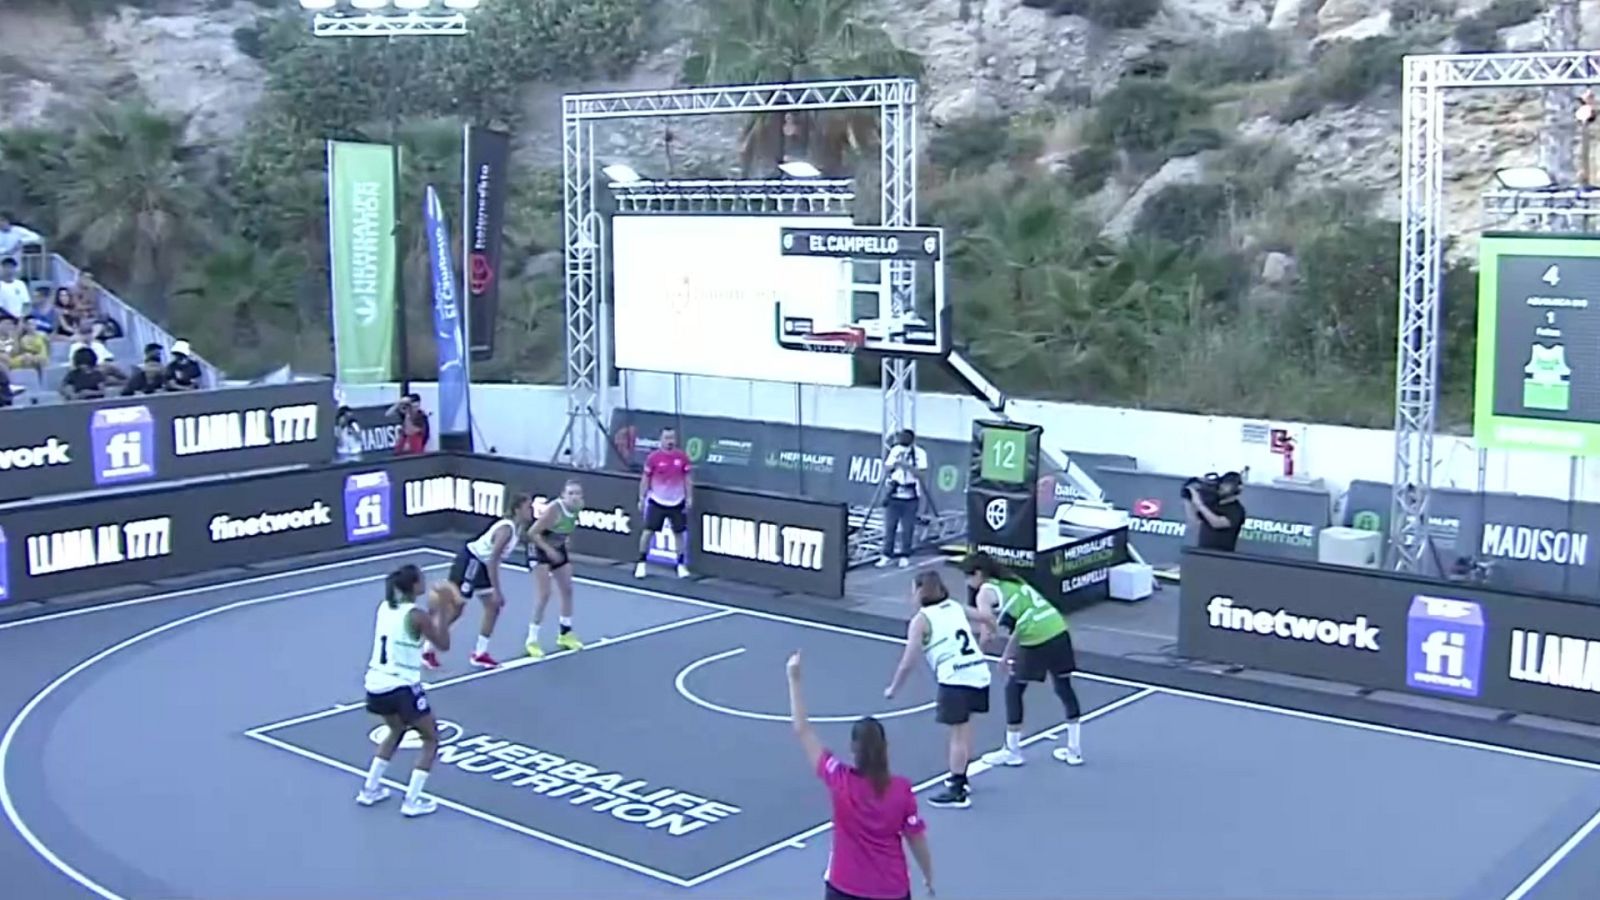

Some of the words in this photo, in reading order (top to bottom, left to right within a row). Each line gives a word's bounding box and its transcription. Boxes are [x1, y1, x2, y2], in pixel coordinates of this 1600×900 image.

[809, 235, 824, 251] EL
[826, 236, 898, 253] CAMPELLO
[1542, 264, 1560, 286] 4
[1546, 311, 1555, 324] 1
[106, 431, 141, 468] fi
[174, 412, 242, 456] LLAMA
[244, 410, 271, 447] AL
[271, 404, 318, 444] 1777
[992, 441, 1017, 469] 12
[355, 493, 381, 527] fi
[405, 476, 454, 515] LLAMA
[455, 477, 473, 512] AL
[472, 480, 505, 517] 1777
[210, 500, 331, 541] finetwork
[1243, 518, 1313, 537] ERBALIFE
[27, 528, 96, 577] LLAMA
[97, 524, 125, 564] AL
[124, 516, 171, 560] 1777
[702, 514, 757, 560] LLAMA
[757, 522, 781, 563] AL
[781, 526, 825, 570] 1777
[1482, 523, 1588, 566] MADISON
[955, 629, 975, 656] 2
[1207, 596, 1381, 650] finetwork
[379, 635, 388, 665] 1
[1421, 630, 1465, 677] fi
[437, 745, 708, 836] NUTRITION
[459, 734, 743, 824] HERBALIFE
